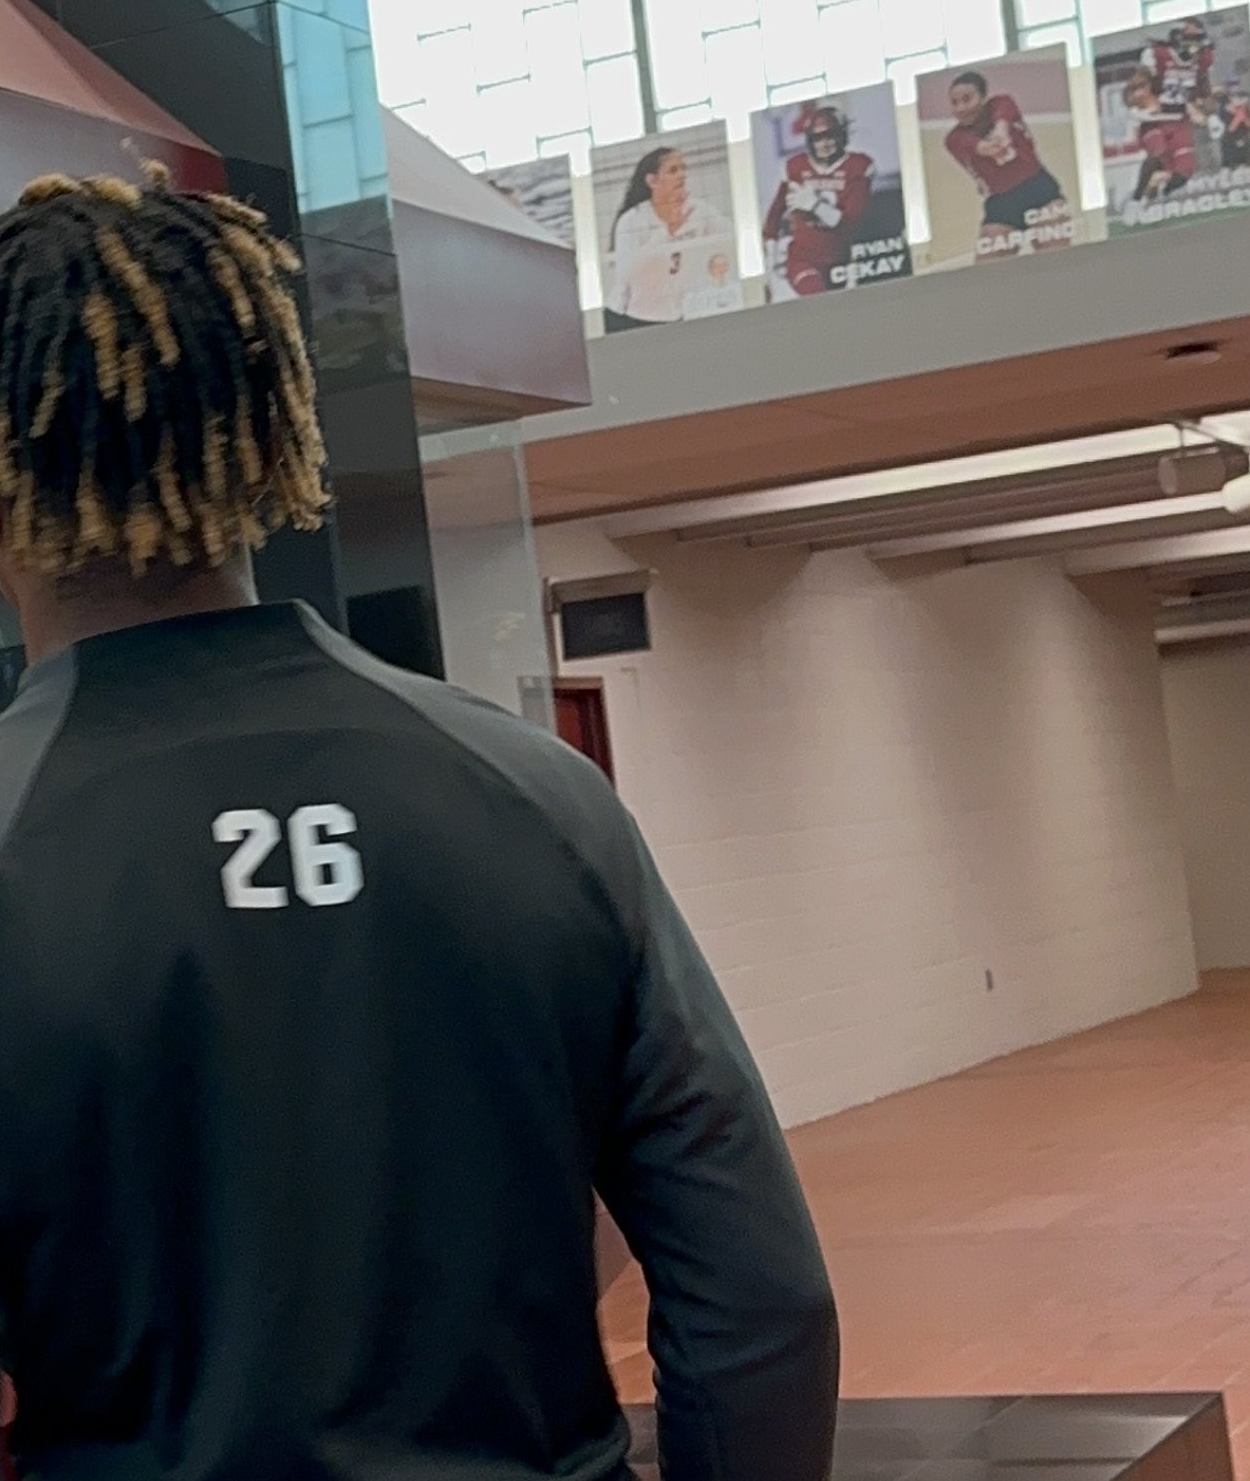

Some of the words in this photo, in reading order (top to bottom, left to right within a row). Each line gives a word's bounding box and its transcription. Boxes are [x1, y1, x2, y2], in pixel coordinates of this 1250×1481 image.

[851, 236, 904, 260] RYAN
[830, 254, 905, 284] CEKAY
[211, 803, 365, 908] 26
